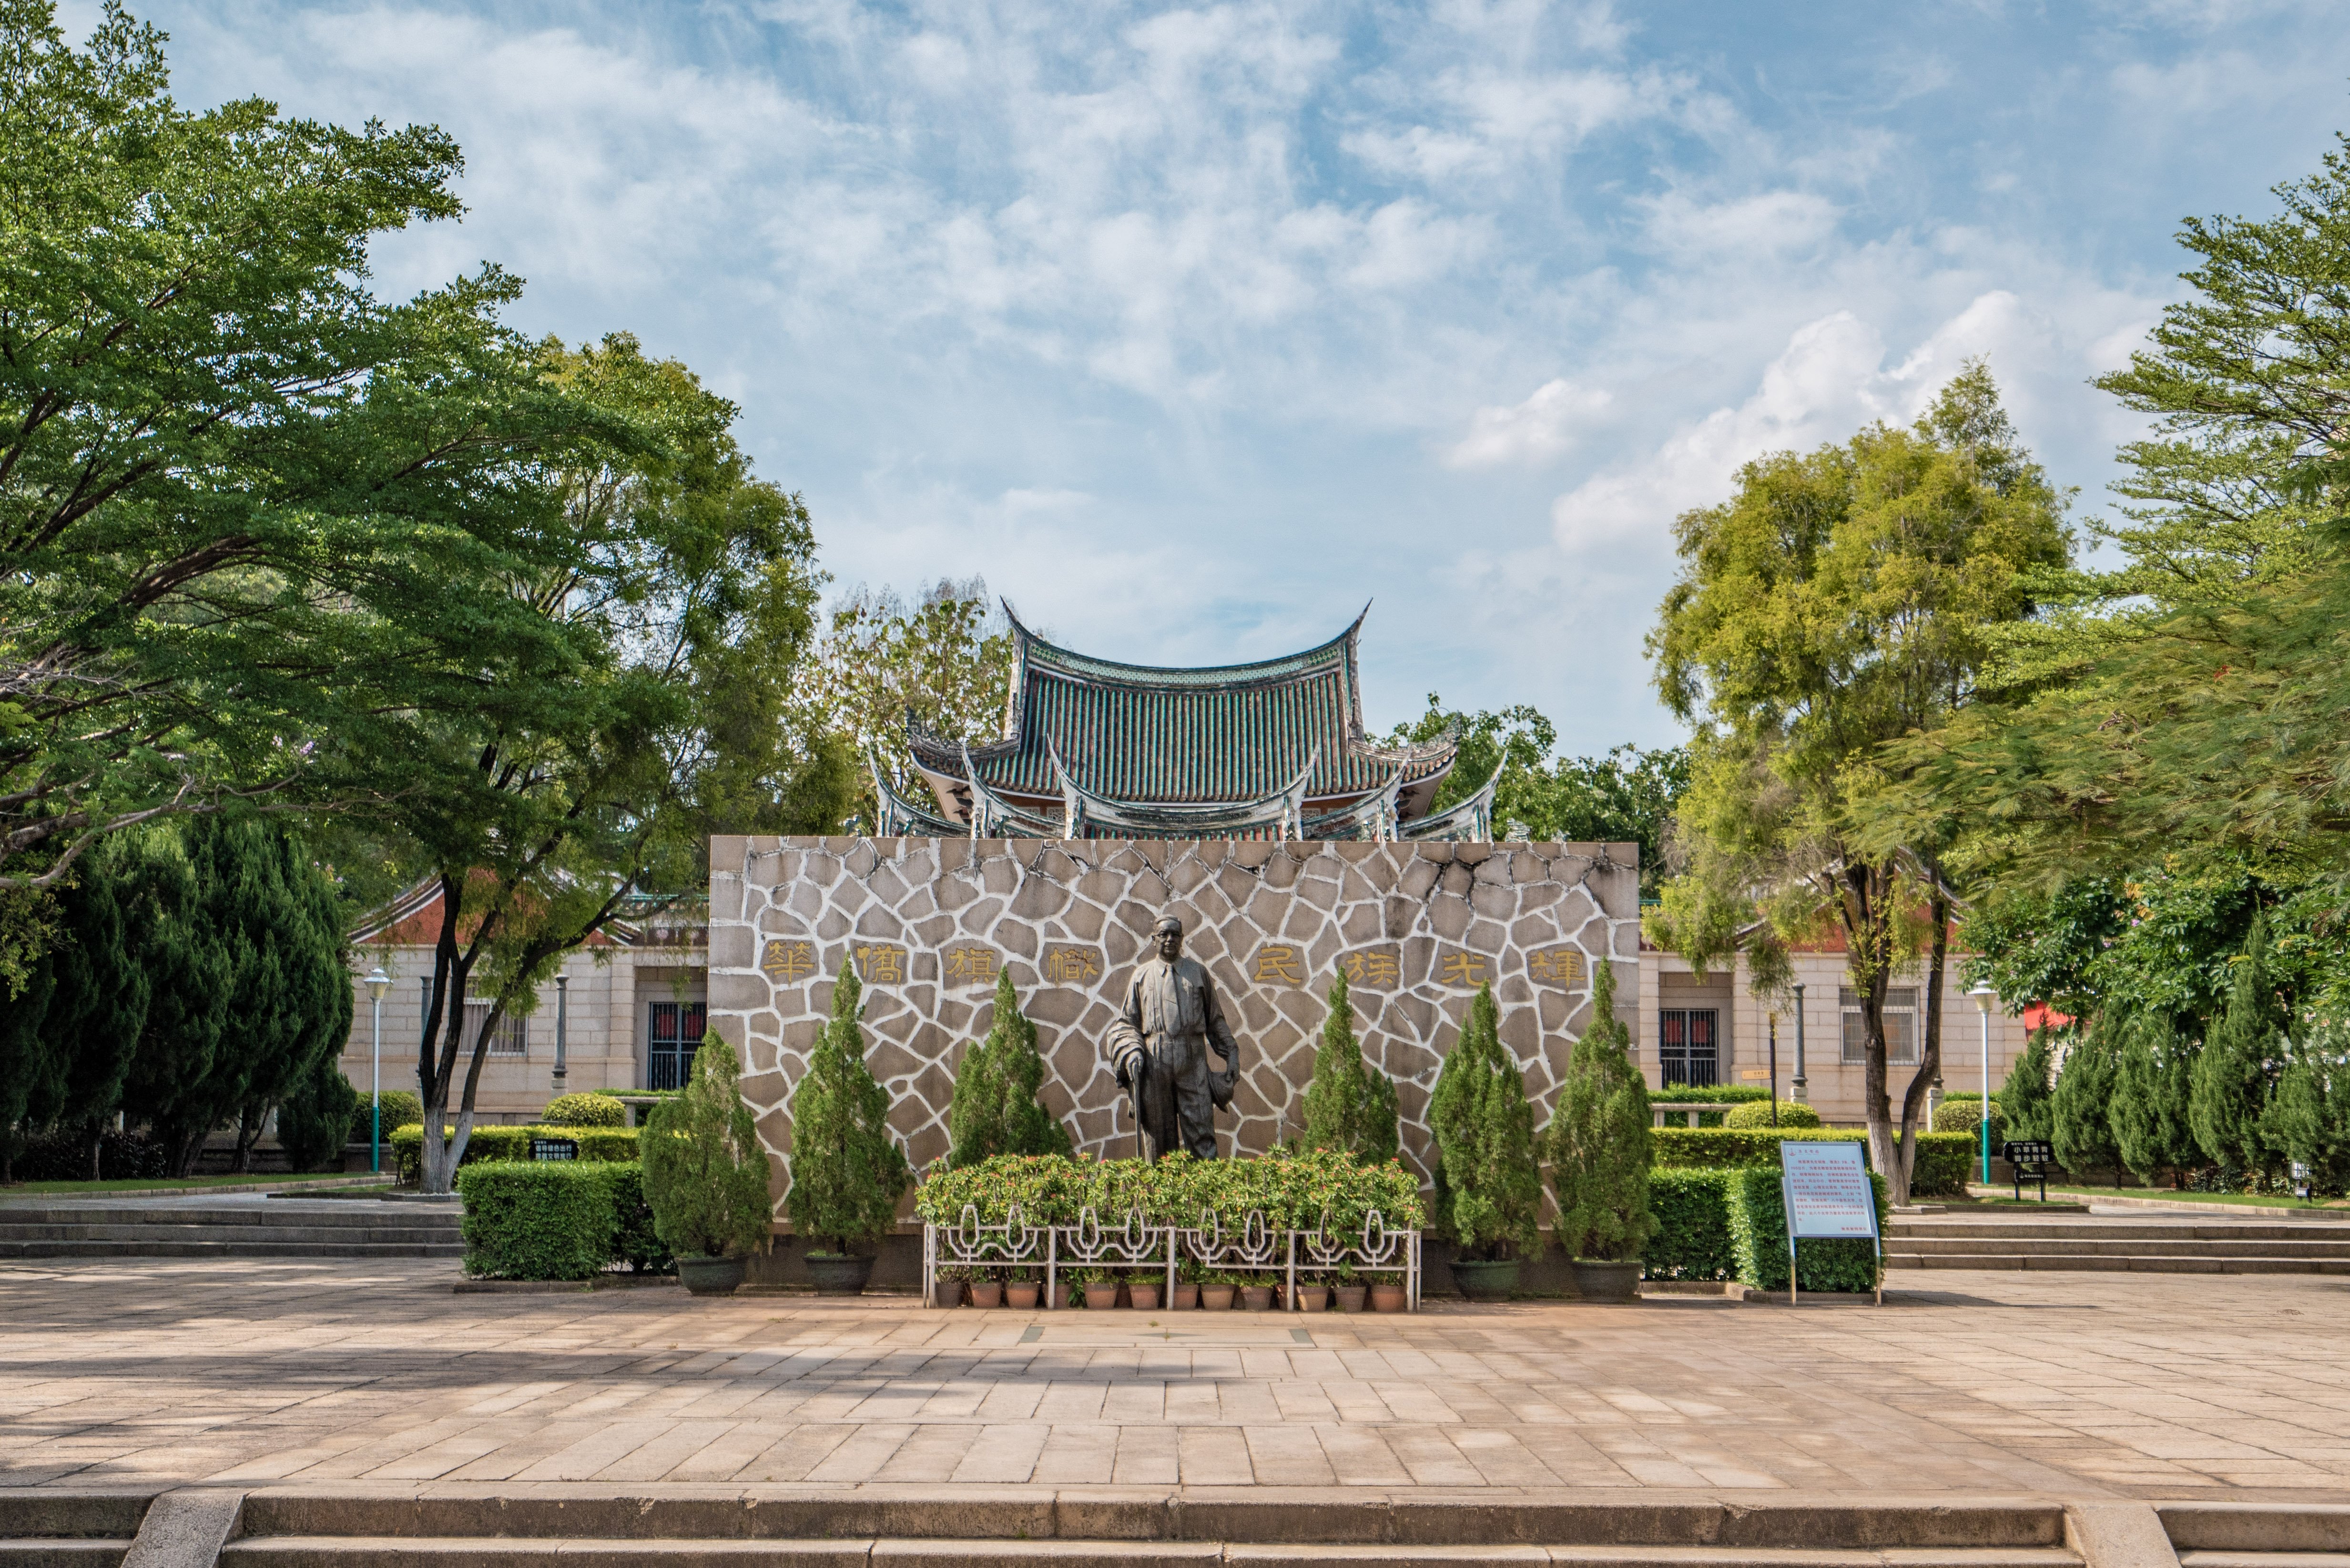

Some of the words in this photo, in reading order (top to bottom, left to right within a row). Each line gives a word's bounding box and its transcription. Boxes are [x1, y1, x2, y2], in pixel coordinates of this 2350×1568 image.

[763, 940, 1099, 983] 華僑旗幟
[1254, 947, 1587, 986] 民族光輝
